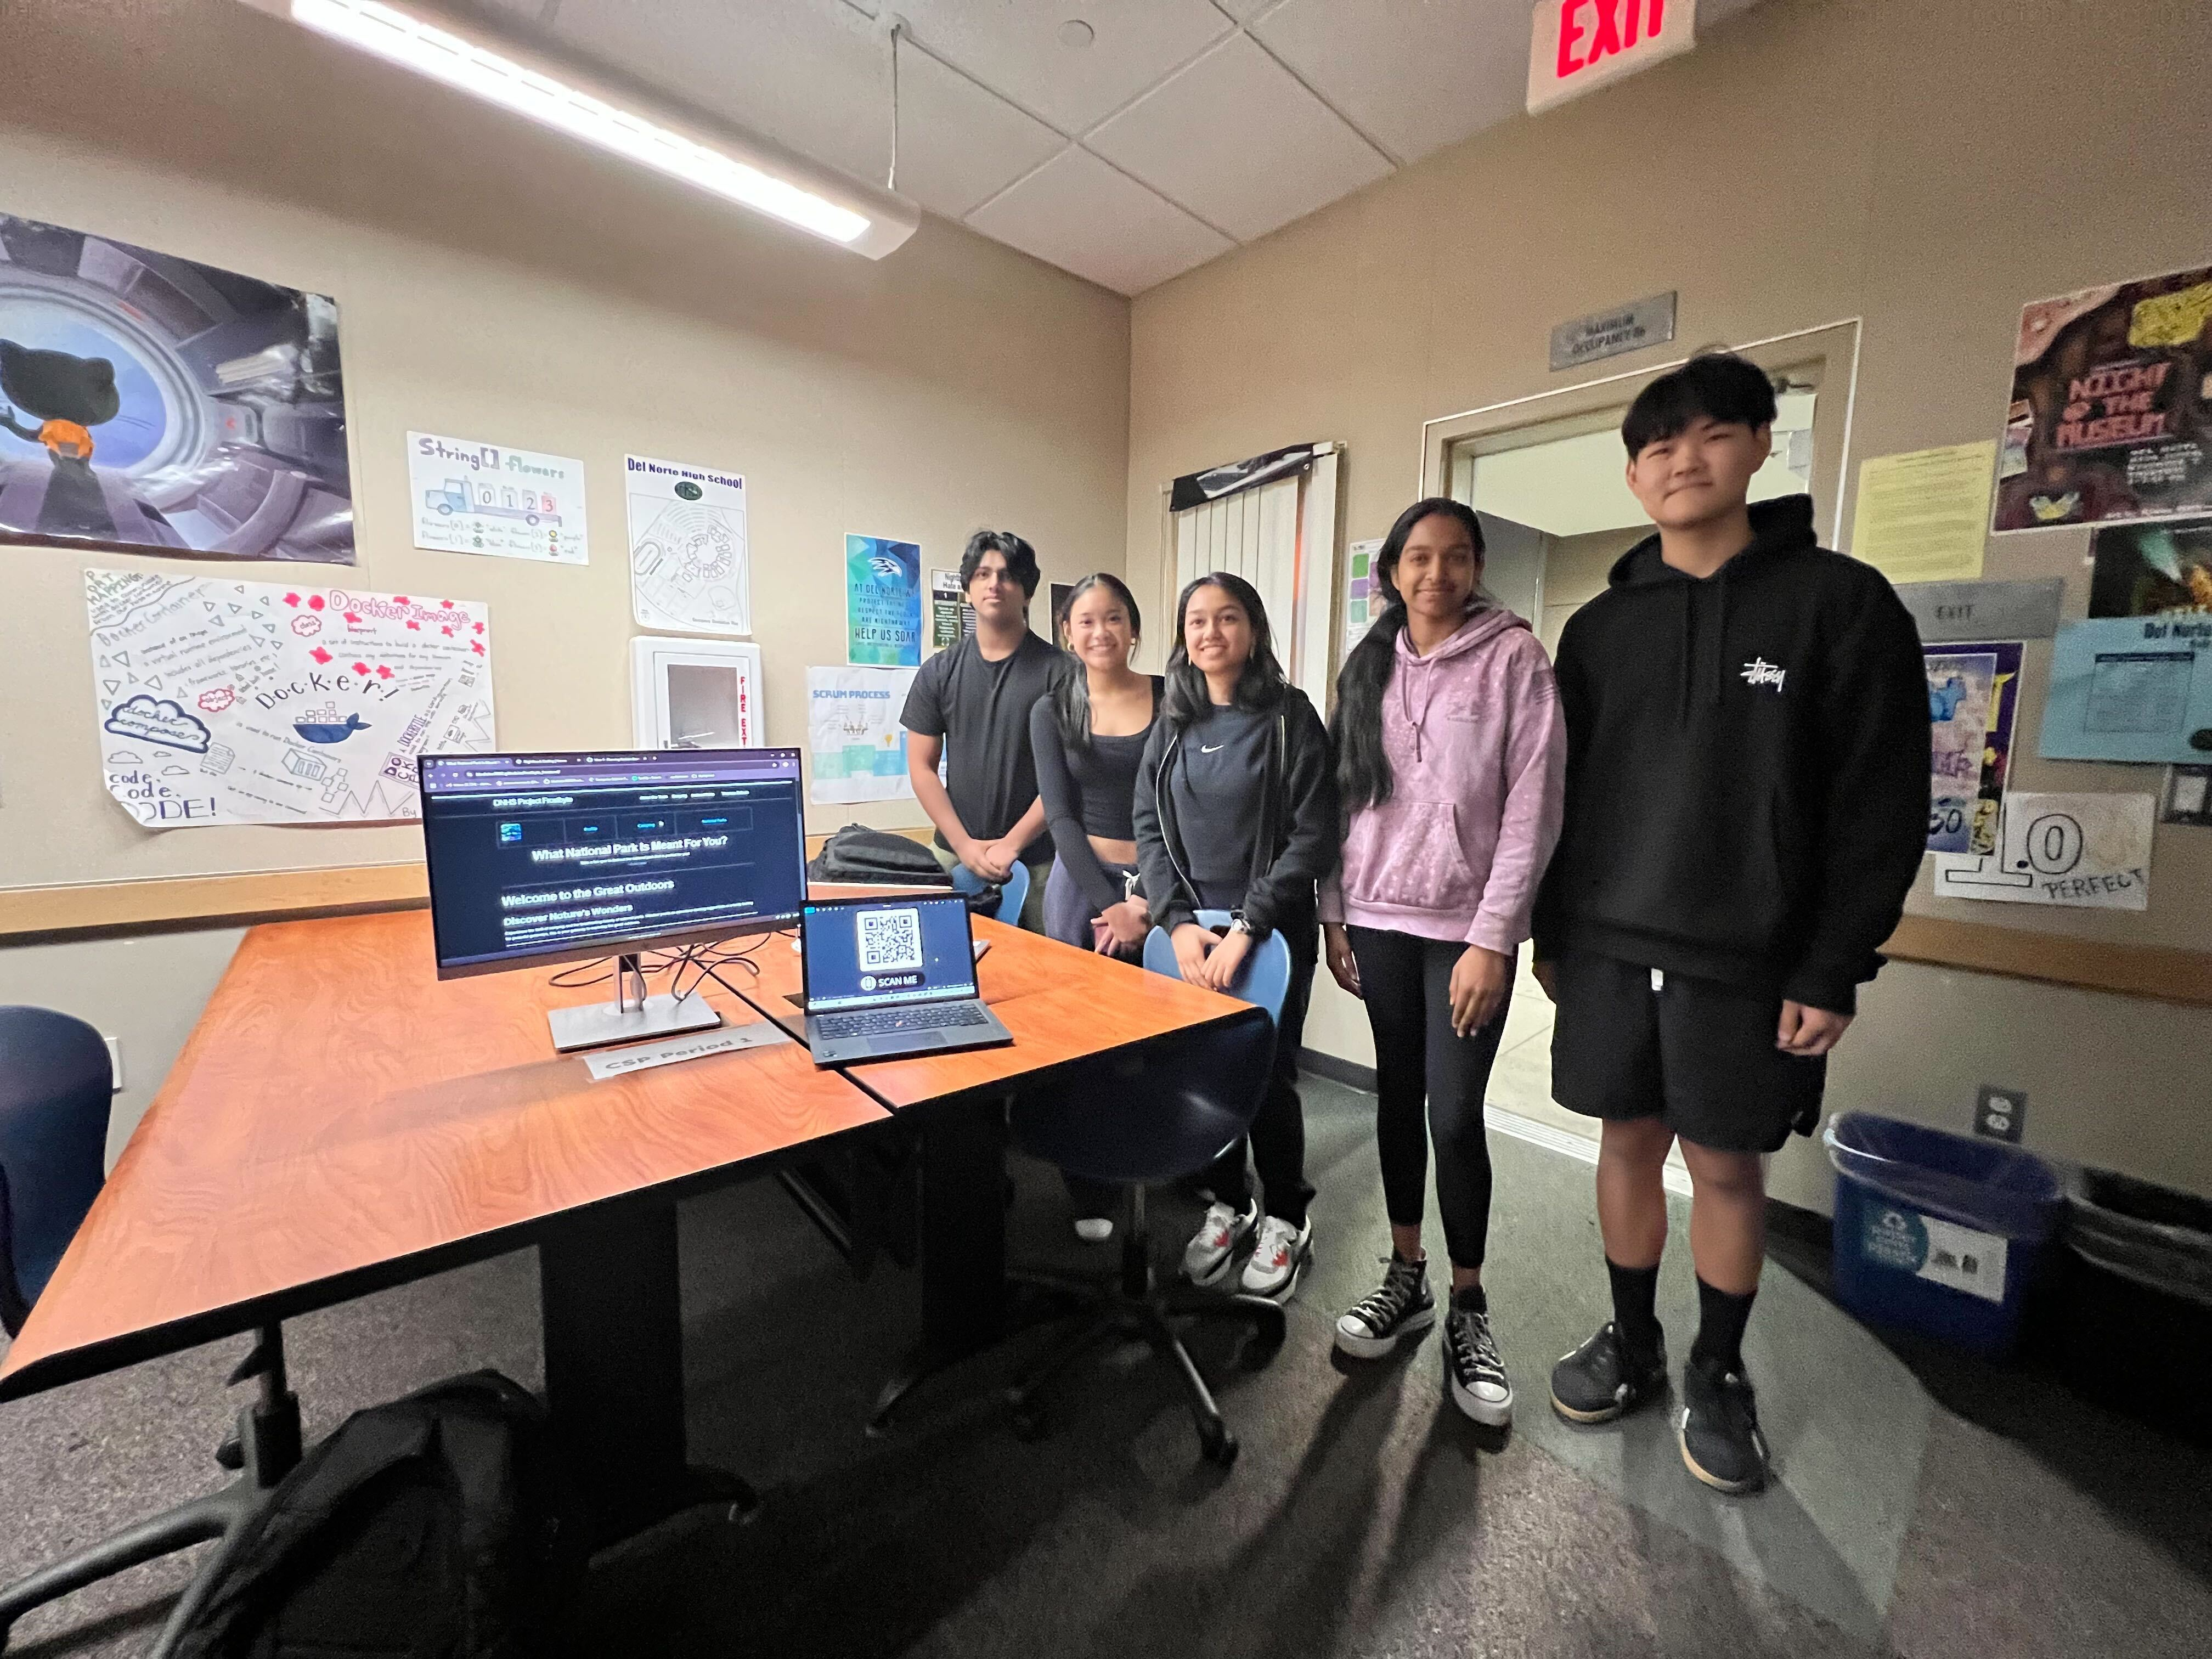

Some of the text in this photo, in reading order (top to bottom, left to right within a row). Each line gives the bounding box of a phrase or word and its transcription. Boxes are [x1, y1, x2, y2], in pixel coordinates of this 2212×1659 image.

[628, 458, 742, 490] Del Norte High School
[854, 583, 862, 593] AT
[866, 584, 878, 595] DEL
[329, 590, 471, 630] Docker Image
[855, 627, 916, 642] HELP US SOAR
[812, 690, 890, 699] SCRUM PROCESS
[493, 798, 517, 807] DNHS
[531, 835, 729, 861] What National Park Is Meant For You?
[501, 879, 675, 907] Welcome to the Great Outdoors
[2041, 868, 2143, 900] PERFECT
[503, 913, 548, 927] Discover
[549, 907, 591, 921] Nature's
[591, 903, 634, 916] Wonders
[877, 974, 918, 988] SCAN ME
[605, 1056, 651, 1070] CSP
[659, 1040, 733, 1059] Period
